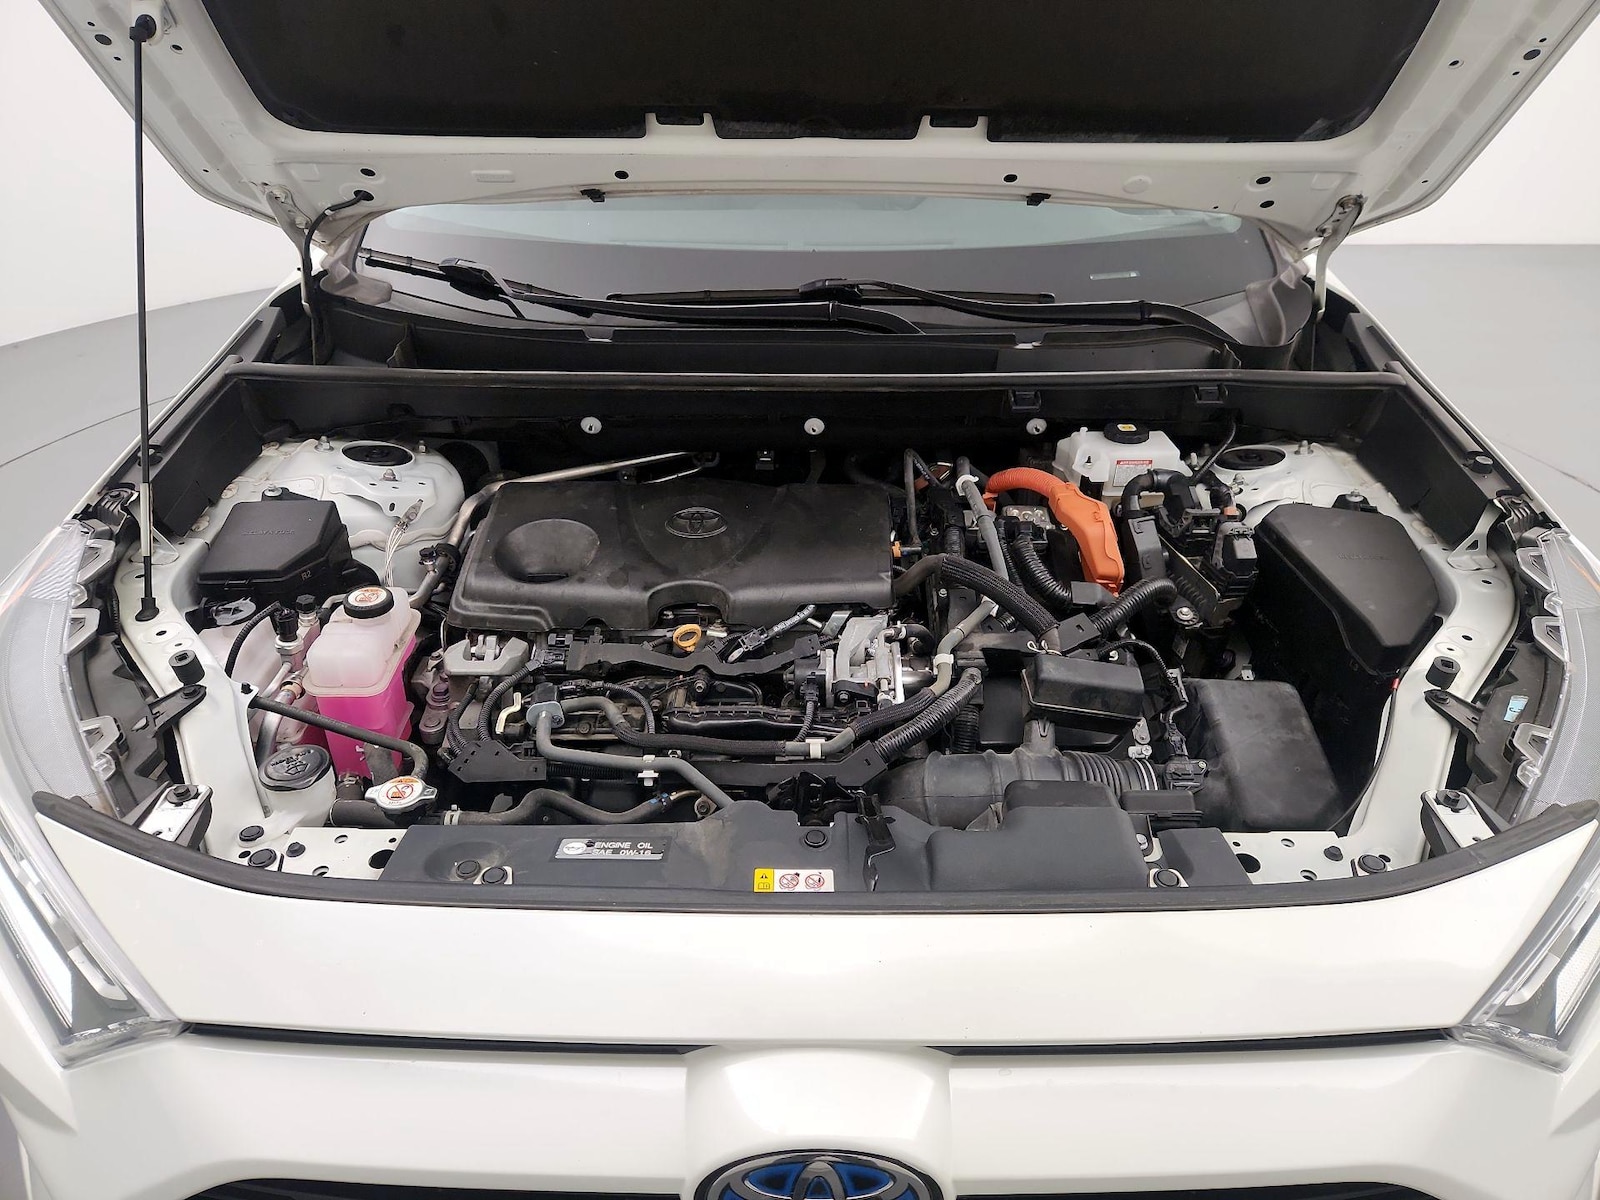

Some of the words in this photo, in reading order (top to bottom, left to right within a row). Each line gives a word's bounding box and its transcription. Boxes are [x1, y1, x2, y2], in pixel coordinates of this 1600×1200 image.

[301, 570, 312, 581] R2
[593, 841, 632, 849] ENGINE
[636, 841, 654, 849] OIL
